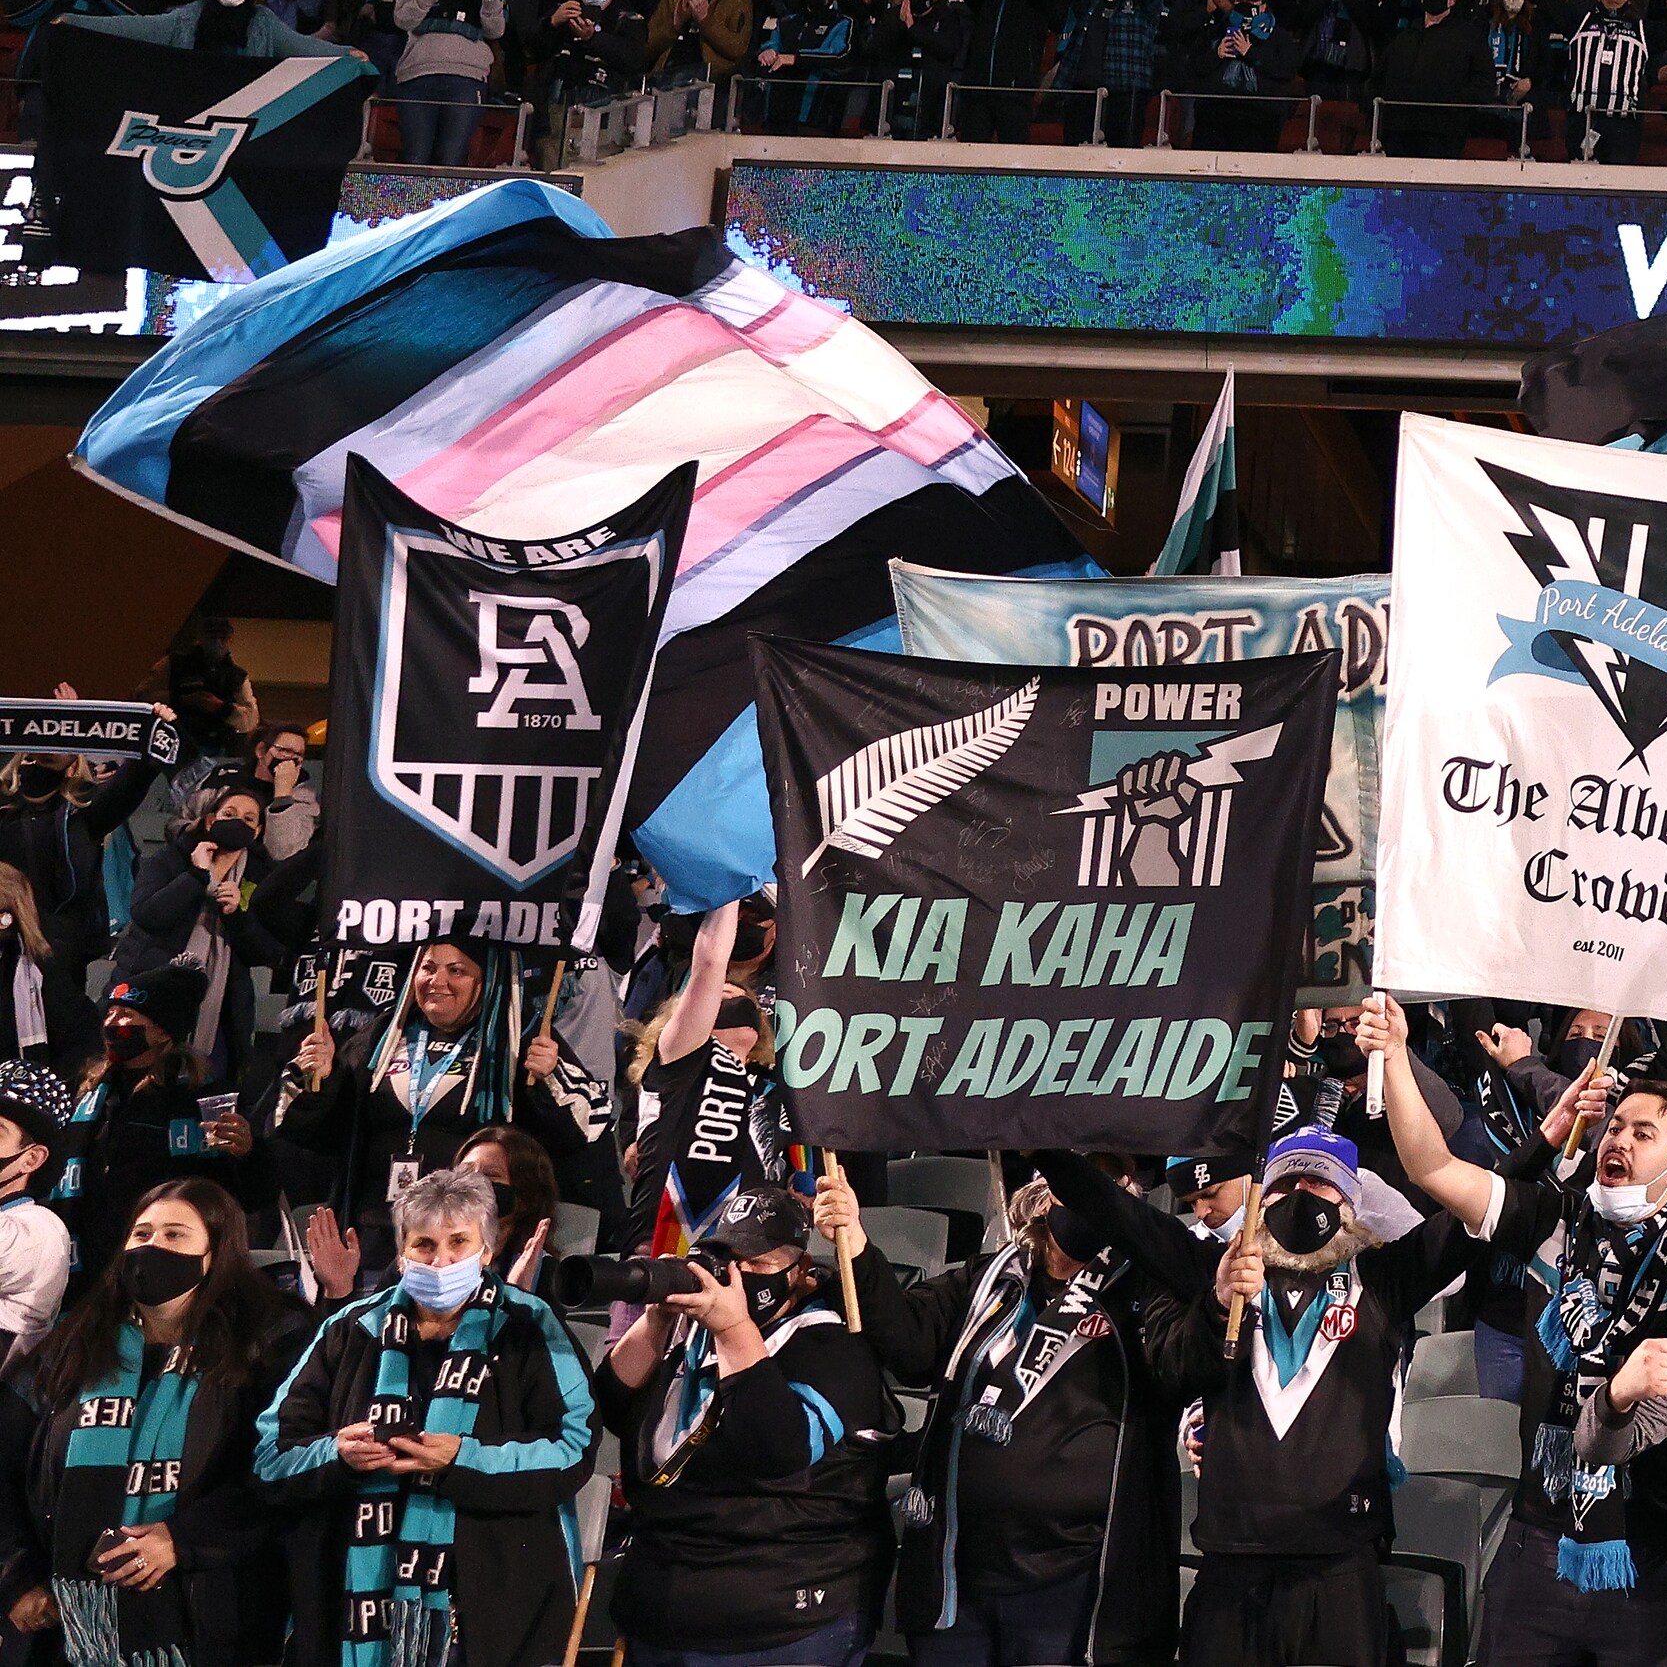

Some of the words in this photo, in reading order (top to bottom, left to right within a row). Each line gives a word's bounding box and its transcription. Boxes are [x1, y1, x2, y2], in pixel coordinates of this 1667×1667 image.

[439, 523, 518, 565] WE
[524, 526, 617, 566] ARE
[1541, 586, 1597, 625] Port
[1286, 609, 1392, 694] AD
[524, 713, 562, 729] 1870
[1095, 684, 1242, 721] POWER
[22, 719, 141, 742] ADELAIDE
[1443, 756, 1548, 827] The
[337, 899, 465, 946] PORT
[822, 891, 969, 985] KIA
[979, 893, 1197, 990] KAHA
[1573, 938, 1597, 954] est
[1599, 940, 1624, 962] 2011
[774, 998, 945, 1097] PORT
[935, 1016, 1275, 1103] ADELAIDE
[687, 1072, 748, 1164] PORT
[1286, 1159, 1311, 1172] Play
[1323, 1306, 1355, 1338] MG
